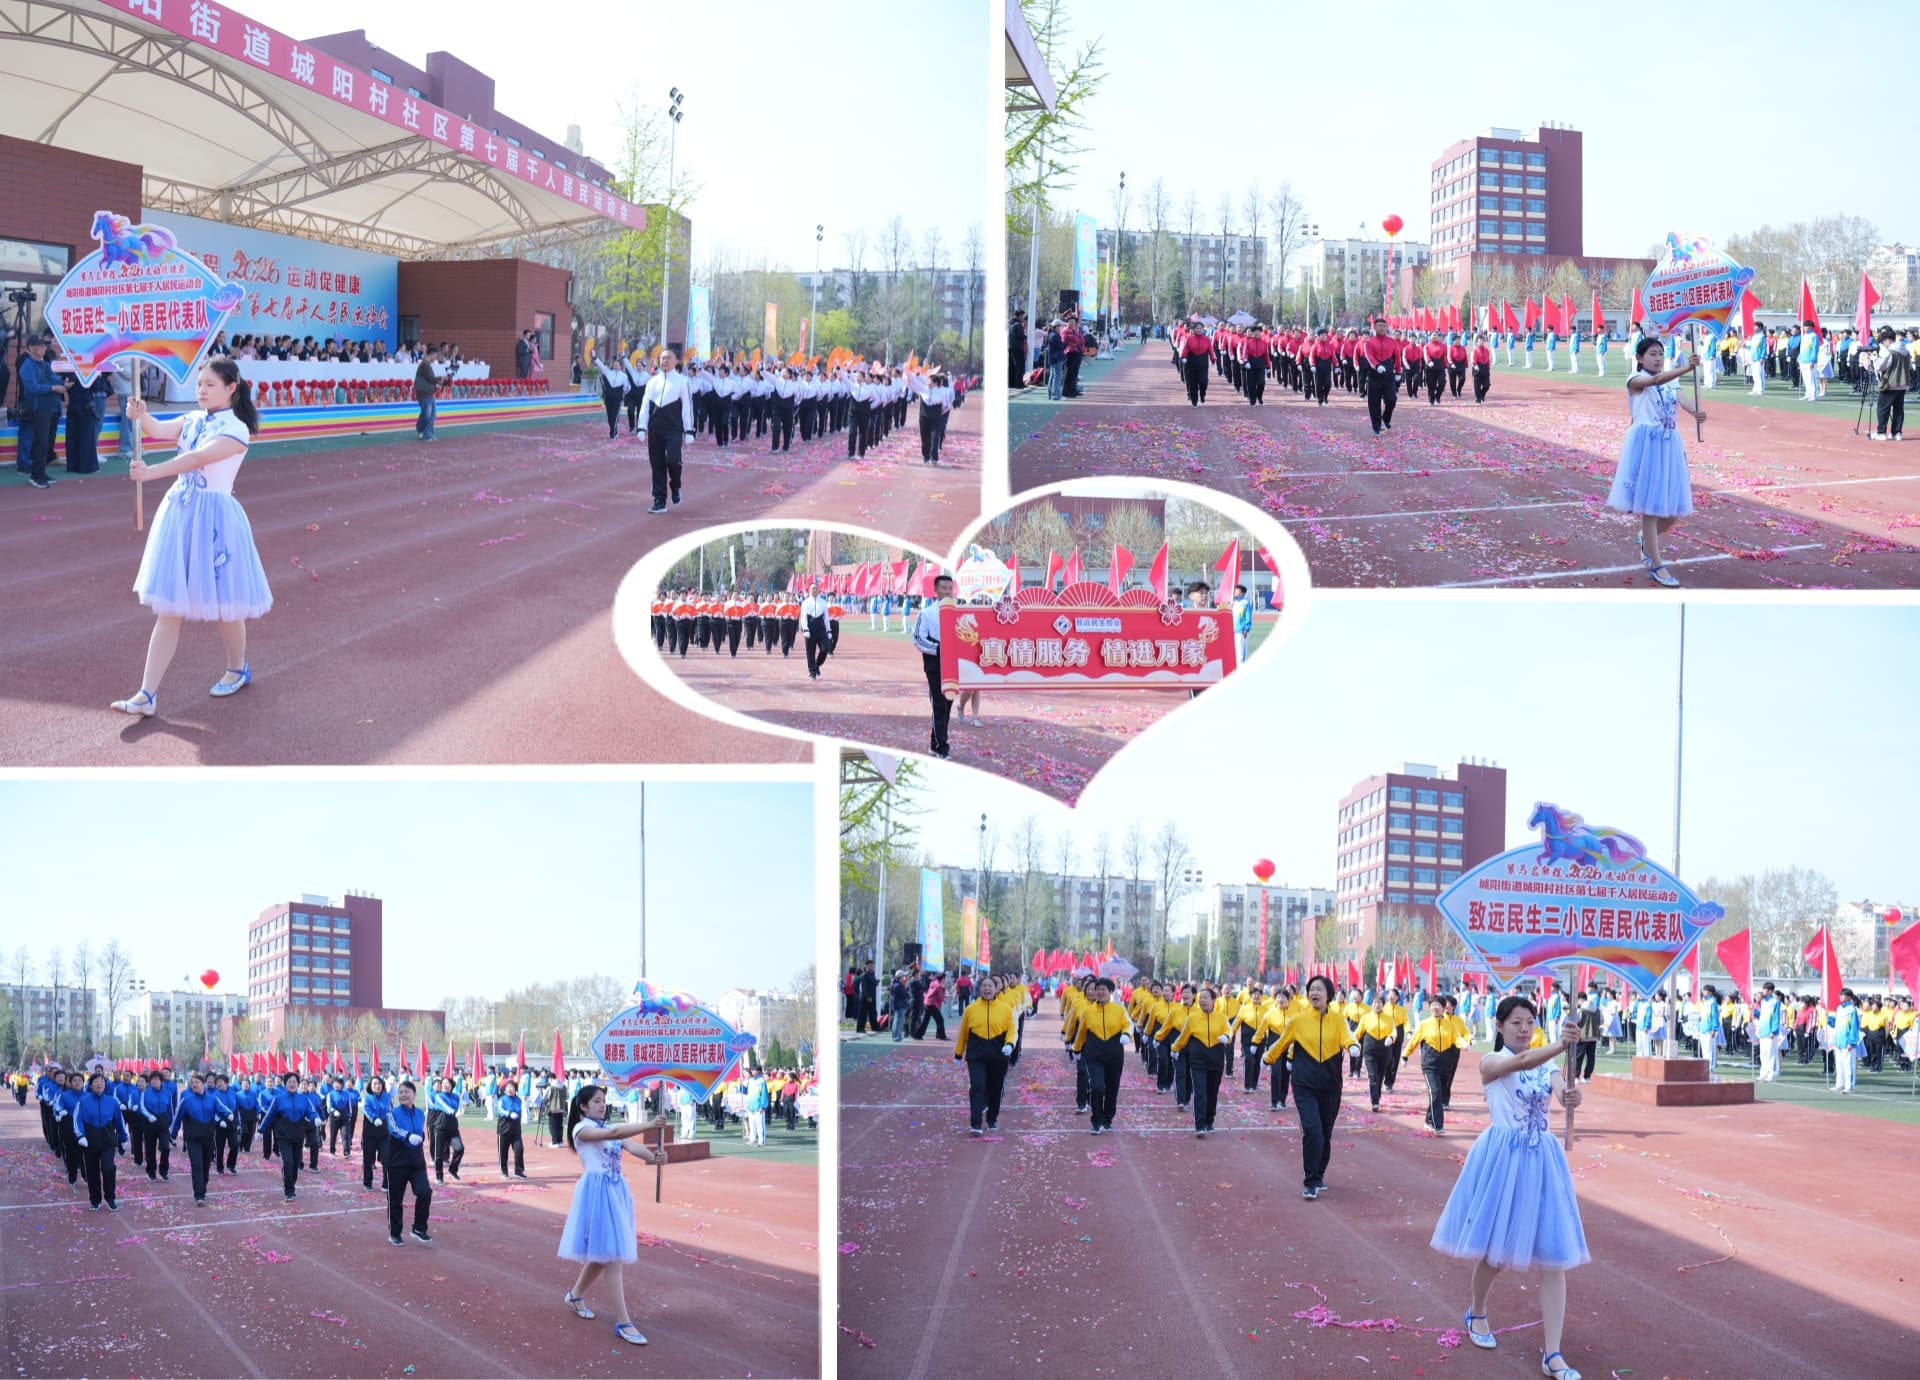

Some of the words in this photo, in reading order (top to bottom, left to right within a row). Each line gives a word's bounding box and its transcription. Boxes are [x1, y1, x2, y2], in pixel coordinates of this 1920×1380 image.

[227, 249, 280, 284] 2026
[287, 266, 361, 295] 运动促健康
[230, 290, 388, 330] 第七届千人居民运动会
[1650, 279, 1735, 312] 致远民生二小区居民代表队
[61, 299, 209, 335] 致远民生一小区居民代表队
[980, 638, 1091, 667] 真情服务
[1100, 638, 1207, 667] 情进万家
[1565, 863, 1602, 880] 2026
[1479, 878, 1678, 902] 城阳街道城阳村社区第七届千人居民运动会
[1468, 900, 1685, 943] 致远民生三小区居民代表队
